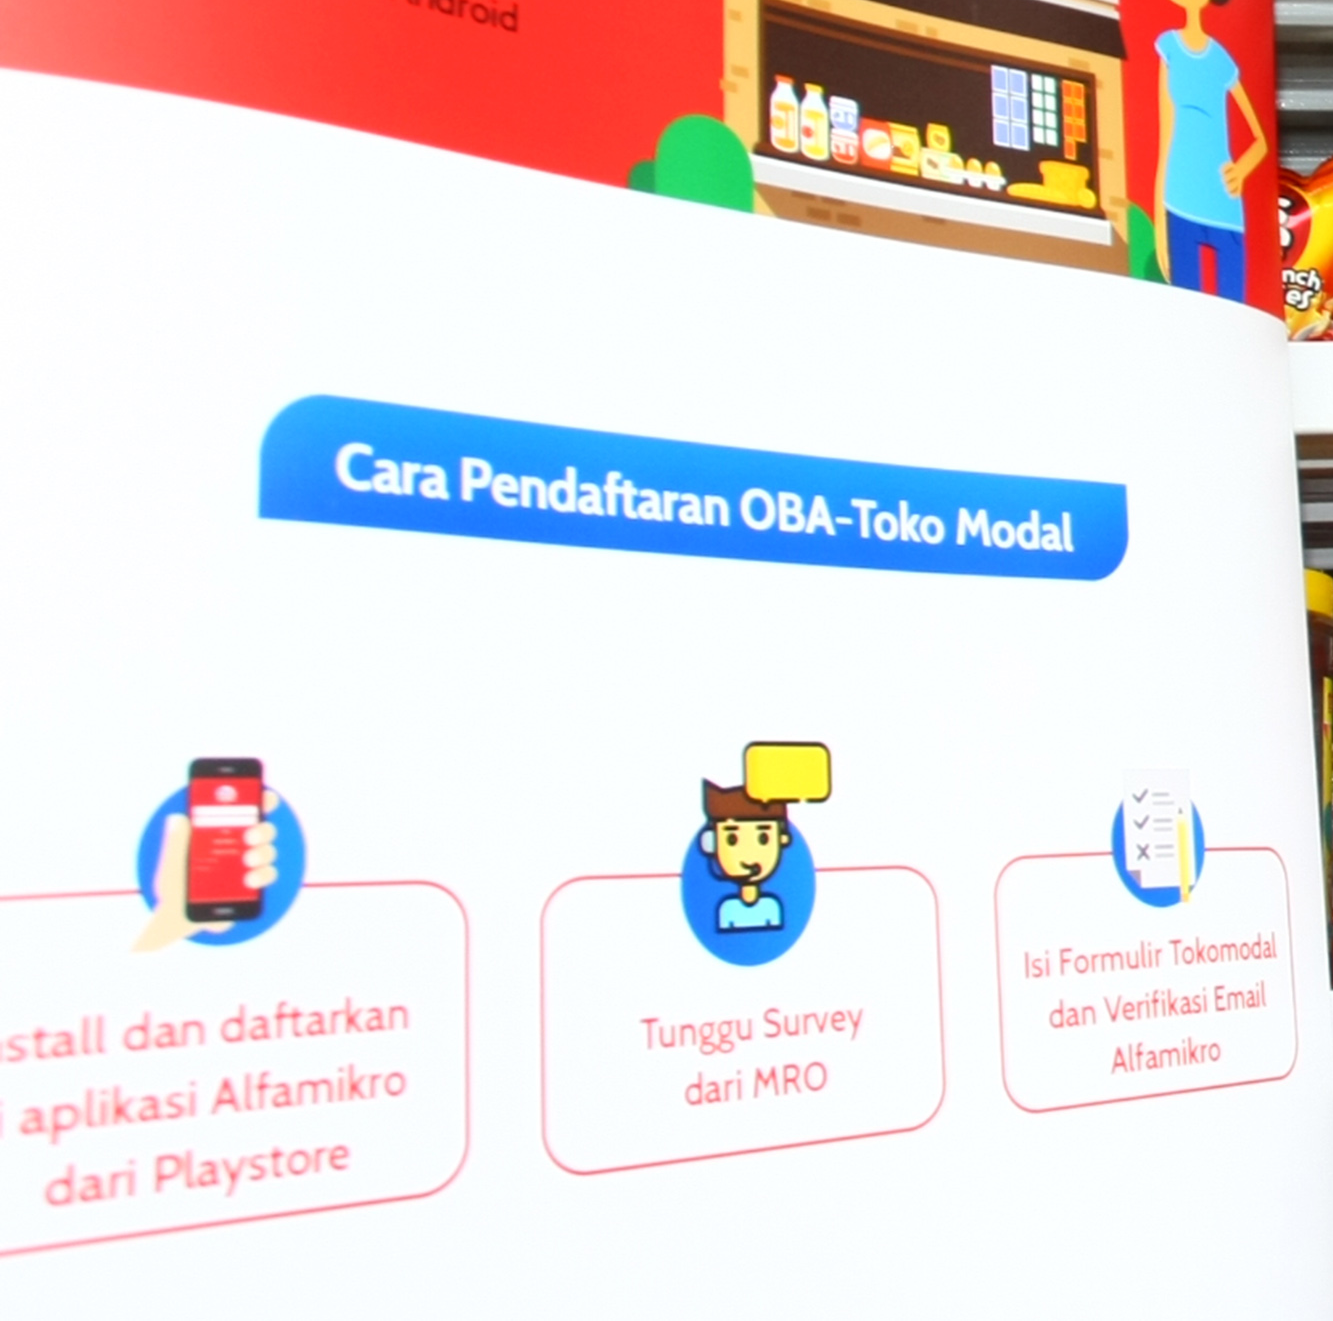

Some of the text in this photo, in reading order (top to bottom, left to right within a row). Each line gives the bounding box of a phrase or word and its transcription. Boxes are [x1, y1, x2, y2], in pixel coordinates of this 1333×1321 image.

[335, 440, 1074, 554] Cara Pendaftaran OBA-Toko Modal
[1023, 932, 1278, 979] Isi Formulir Tokomodal
[122, 1011, 206, 1052] dan
[220, 997, 410, 1044] daftarkan
[640, 1004, 864, 1055] Tunggu Survey
[1048, 981, 1268, 1030] dan Verifikasi Email
[1110, 1038, 1222, 1076] Alfamikro
[18, 1064, 407, 1145] aplikasi Alfamikro
[684, 1062, 829, 1107] dari MRO
[44, 1145, 351, 1207] dari Playstore
